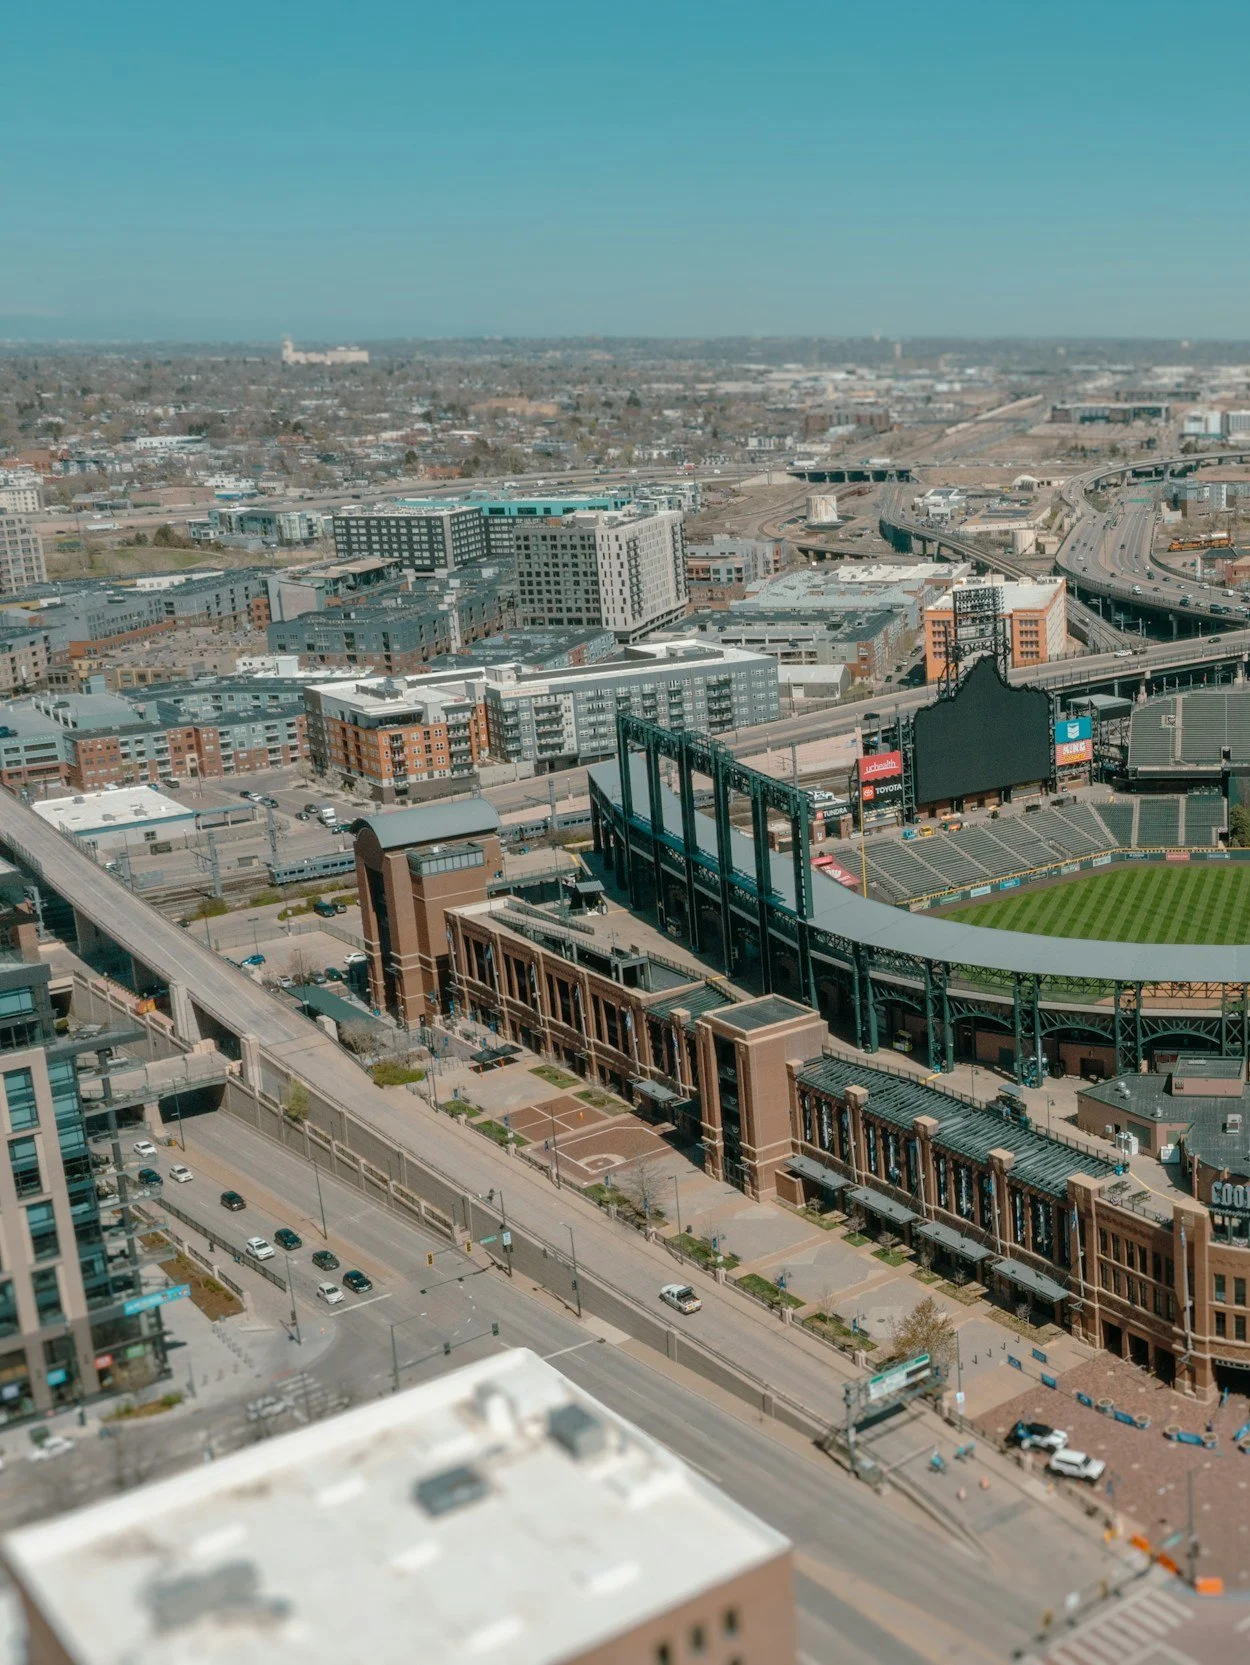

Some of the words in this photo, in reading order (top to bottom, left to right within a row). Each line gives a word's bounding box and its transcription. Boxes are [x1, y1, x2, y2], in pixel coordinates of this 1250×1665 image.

[865, 759, 897, 772] uchealth
[875, 783, 902, 794] TOYOTA
[823, 807, 848, 817] TUNDRA
